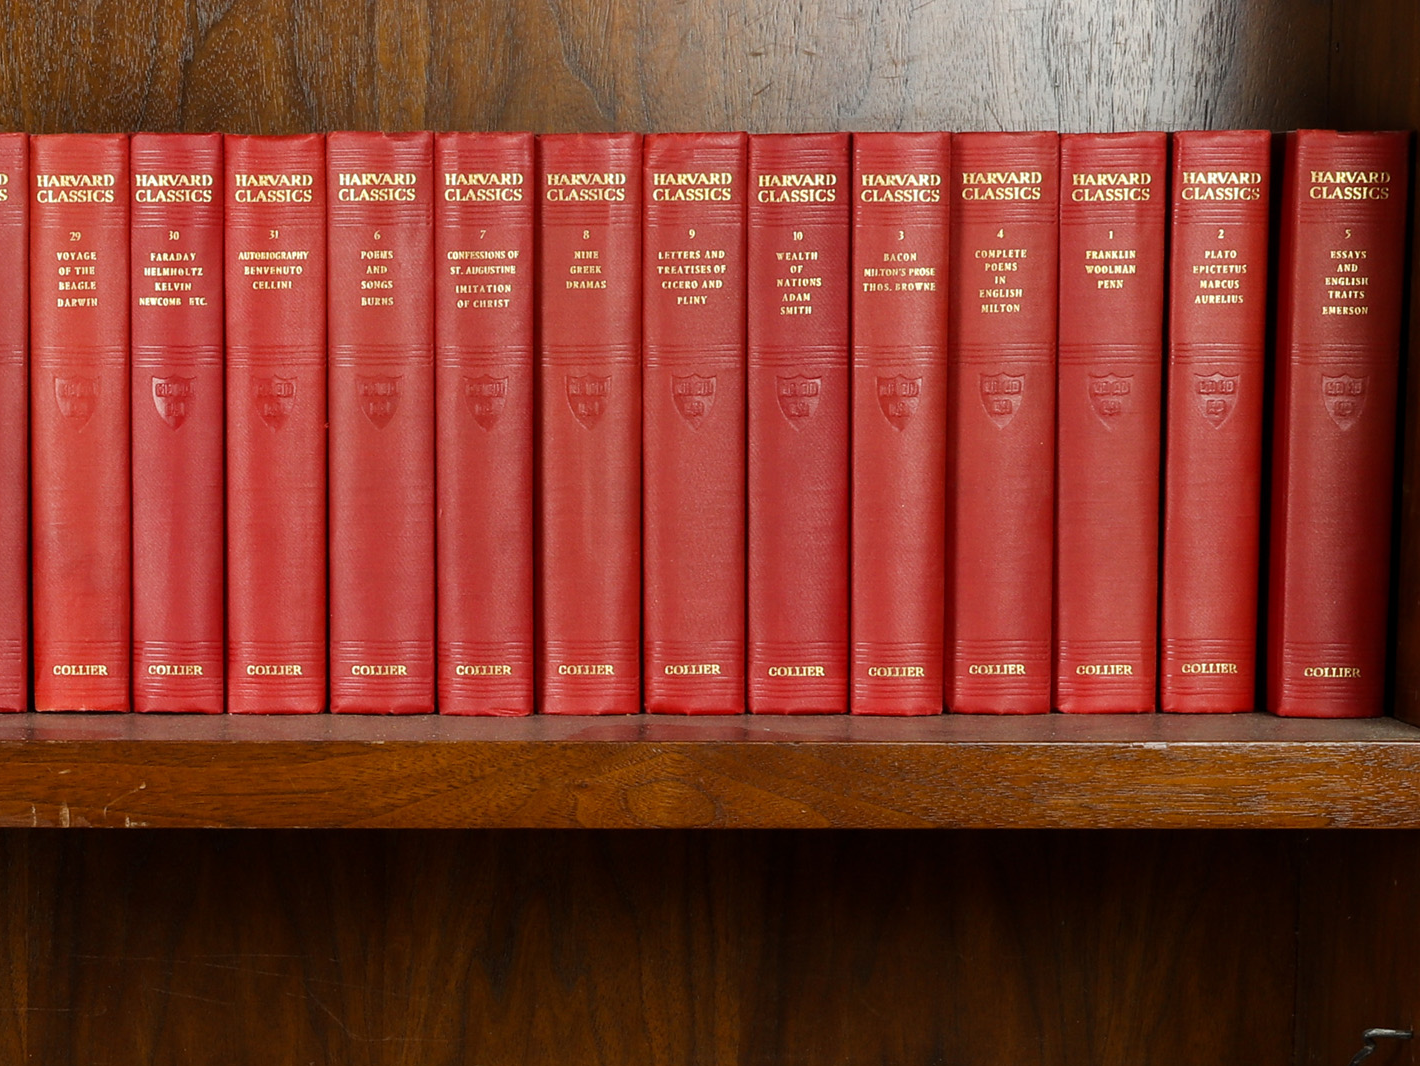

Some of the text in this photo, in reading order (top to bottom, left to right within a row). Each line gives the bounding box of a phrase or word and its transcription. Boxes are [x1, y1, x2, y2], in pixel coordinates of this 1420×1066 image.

[37, 174, 115, 187] HARVARD
[444, 173, 523, 187] HARVARD
[758, 174, 837, 187] HARVARD
[1073, 173, 1151, 185] HARVARD
[1311, 171, 1390, 183] HARVARD
[37, 190, 114, 203] CLASSICS
[444, 187, 522, 202] CLASSICS
[758, 189, 836, 203] CLASSICS
[1072, 188, 1150, 201] CLASSICS
[1310, 186, 1389, 200] CLASSICS
[70, 232, 81, 241] 29
[793, 231, 803, 241] 10
[57, 252, 97, 261] VOYAGE
[447, 250, 519, 260] CONFESSIONS OF
[776, 252, 818, 260] WEALTH
[1086, 250, 1136, 259] FRANKLIN
[1331, 251, 1366, 259] ESSAYS
[58, 266, 95, 275] OF THE
[450, 265, 516, 275] ST. AUGUSTINE
[790, 265, 803, 273] OF
[1085, 264, 1136, 274] WOOLMAN
[1337, 264, 1358, 272] AND
[59, 281, 96, 290] BEAGLE
[777, 278, 822, 287] NATIONS
[1098, 280, 1123, 289] PENN
[1325, 277, 1368, 286] ENGLISH
[456, 284, 511, 293] IMITATION
[782, 293, 810, 301] ADAM
[1328, 291, 1364, 299] TRAITS
[57, 298, 97, 307] DARWIN
[457, 299, 510, 308] OF CHRIST
[780, 306, 812, 315] SMITH
[1322, 306, 1368, 315] EMERSON
[53, 664, 108, 676] COLLIER
[456, 665, 511, 676] COLLIER
[769, 665, 824, 677] COLLIER
[1076, 664, 1132, 675] COLLIER
[1304, 666, 1360, 678] COLLIER
